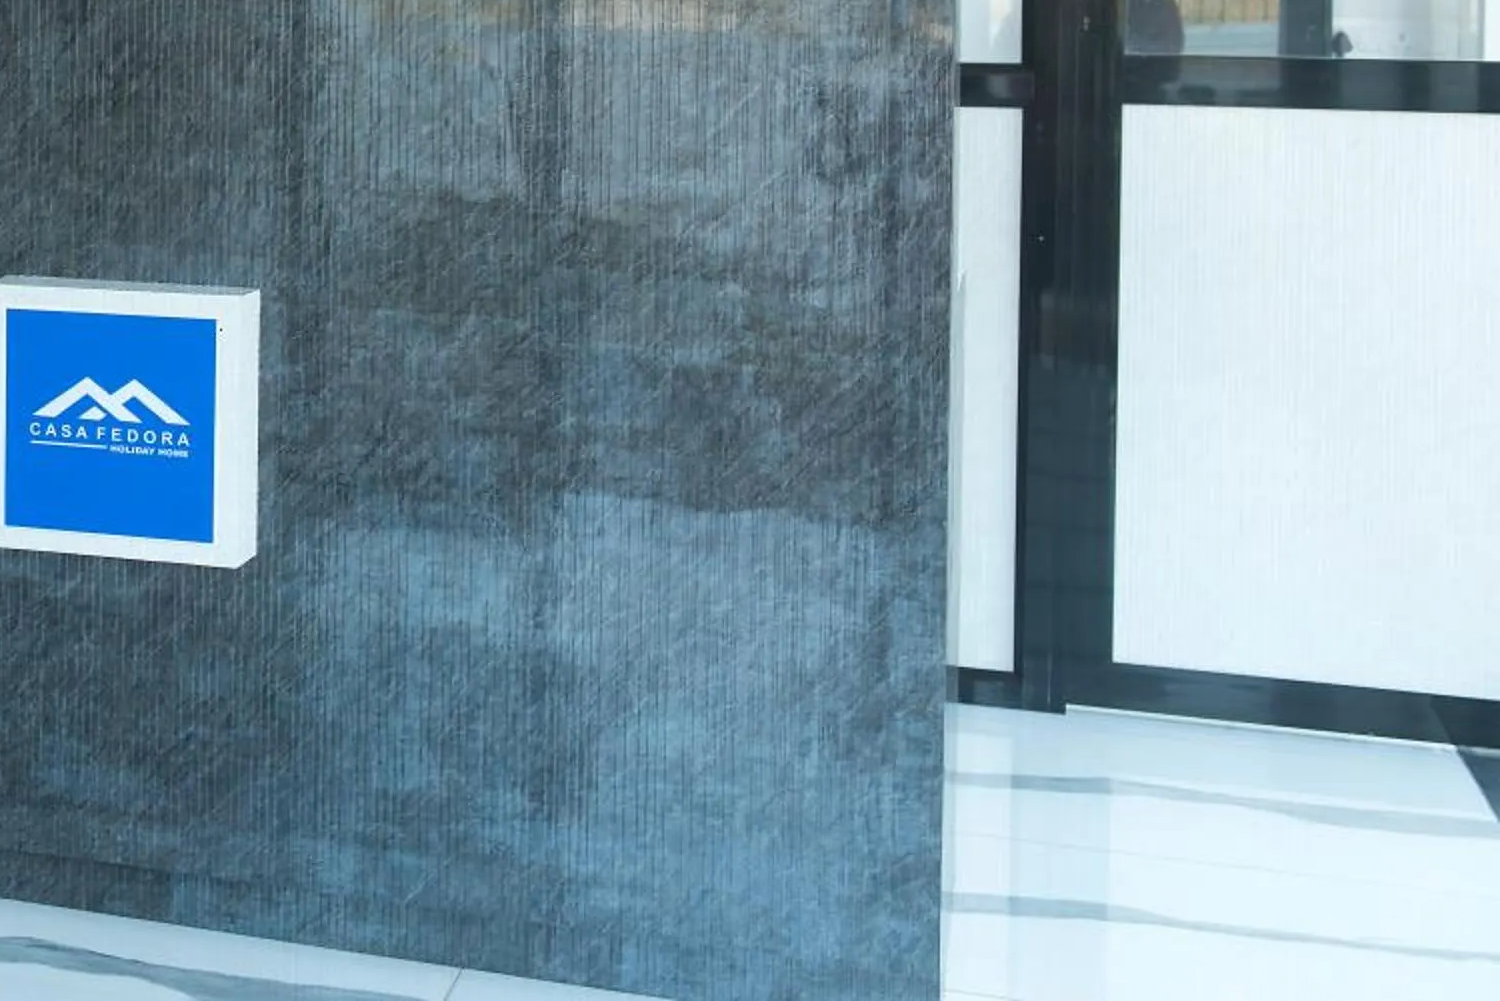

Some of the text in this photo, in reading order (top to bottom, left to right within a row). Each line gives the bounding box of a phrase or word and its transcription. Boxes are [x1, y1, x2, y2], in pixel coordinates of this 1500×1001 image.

[29, 422, 191, 447] CASA FEDORA
[109, 445, 190, 458] HOLIDAY HOME
